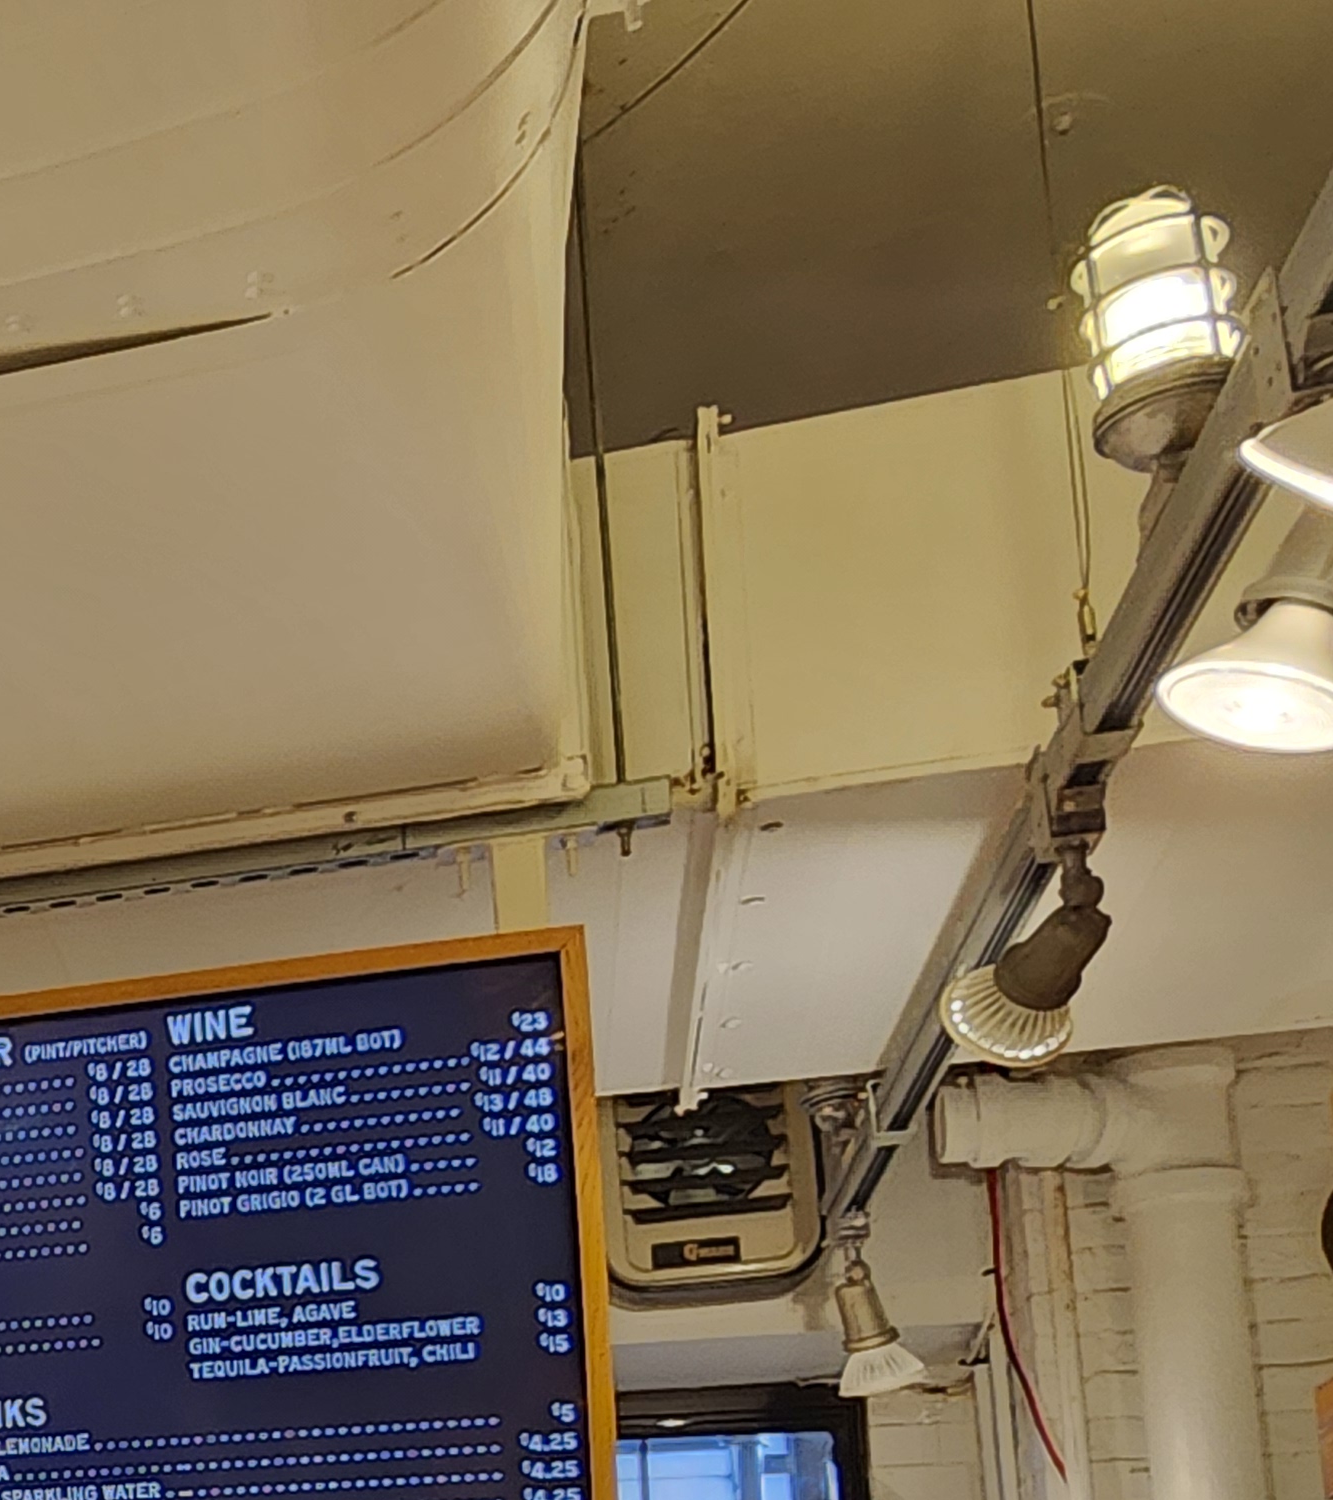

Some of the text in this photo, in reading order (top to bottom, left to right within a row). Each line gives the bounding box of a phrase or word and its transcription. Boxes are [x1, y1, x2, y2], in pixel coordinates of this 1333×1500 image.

[167, 1006, 254, 1045] WINE
[169, 1043, 283, 1073] CHAMPAGNE
[512, 1012, 548, 1031] $23
[171, 1071, 266, 1097] PROSECCO
[180, 1197, 232, 1218] PINOT
[237, 1191, 300, 1212] GRIGIO
[186, 1259, 379, 1303] COCKTAILS
[292, 1301, 356, 1323] AGAVE
[422, 1343, 474, 1362] CHILI
